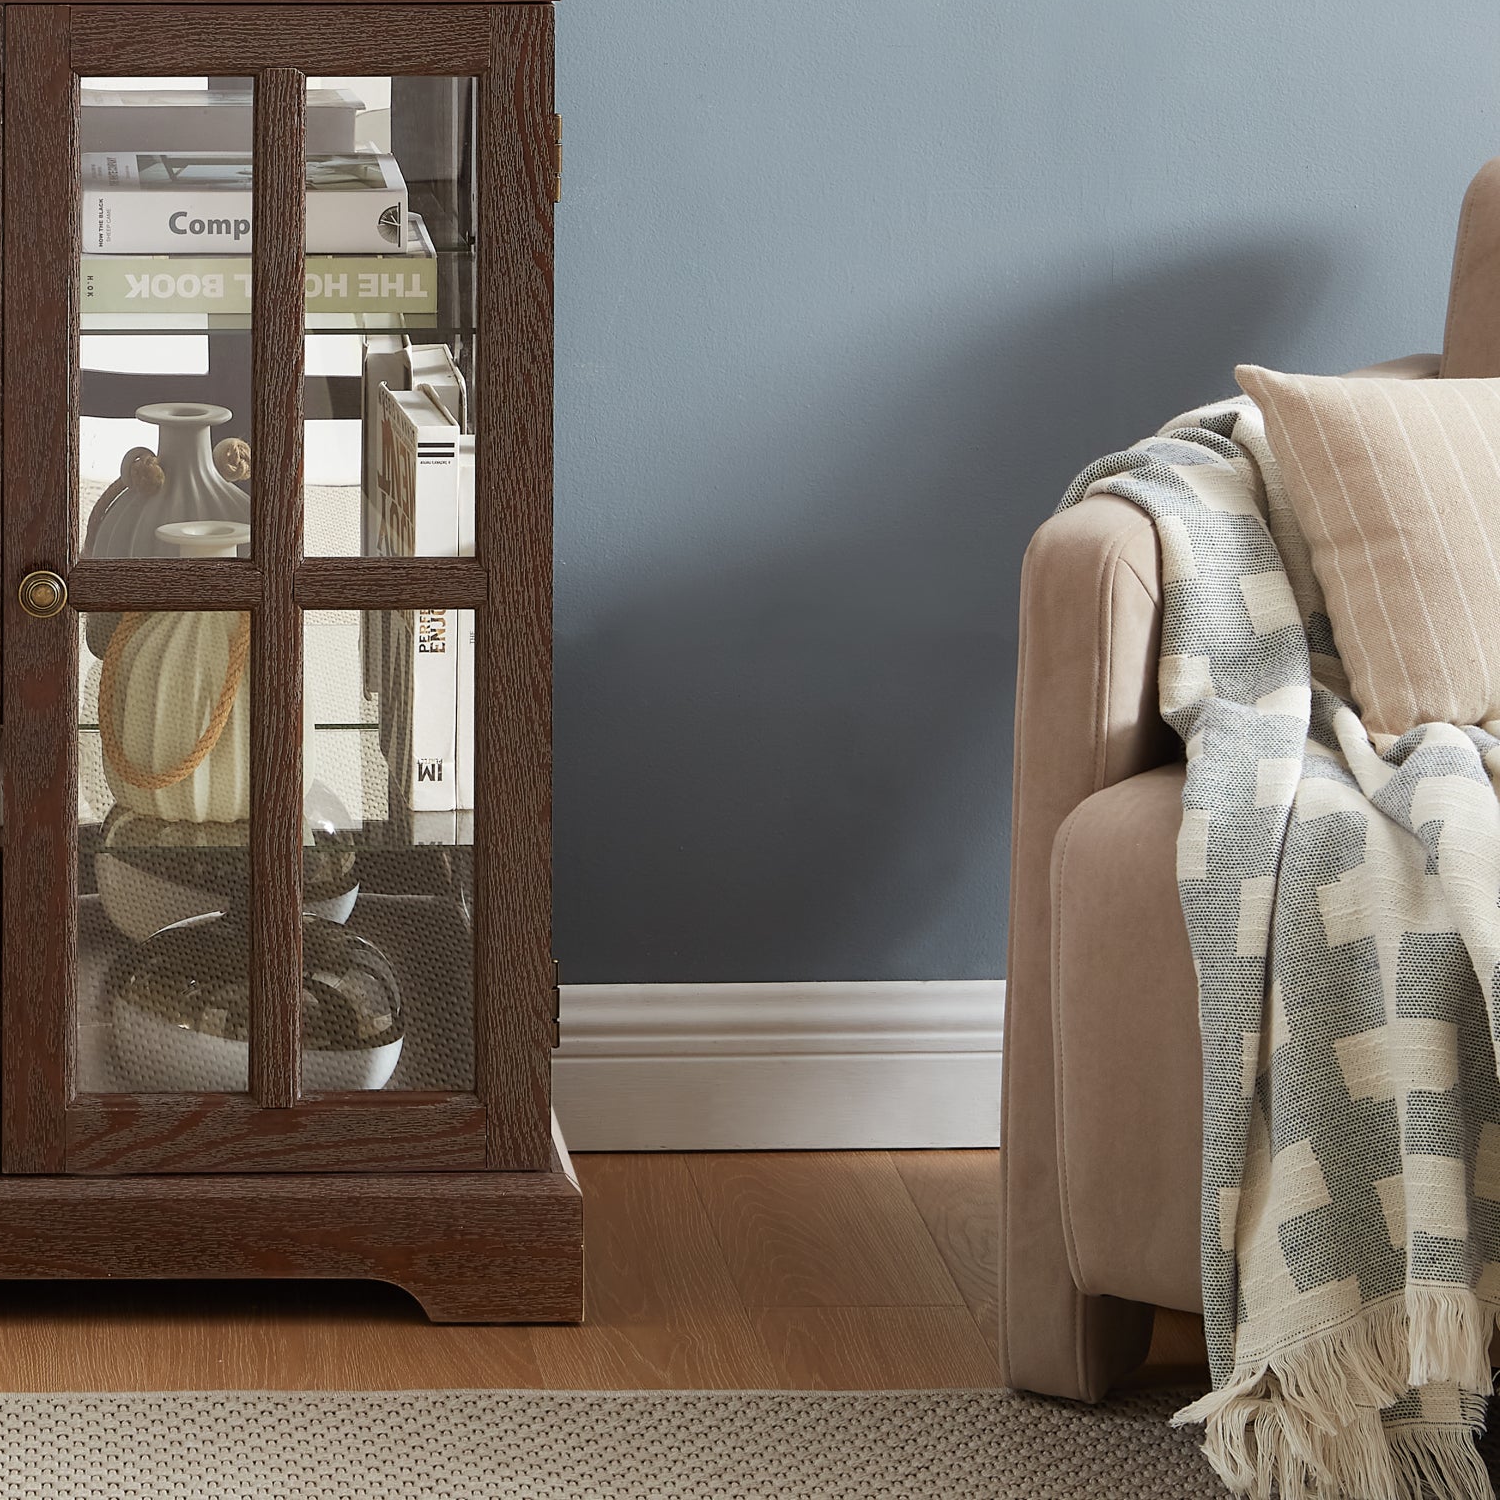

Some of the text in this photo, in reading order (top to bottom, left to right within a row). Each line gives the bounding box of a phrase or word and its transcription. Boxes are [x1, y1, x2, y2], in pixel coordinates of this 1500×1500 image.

[168, 211, 251, 240] Comp
[124, 273, 224, 299] BOOK
[358, 273, 428, 298] THE
